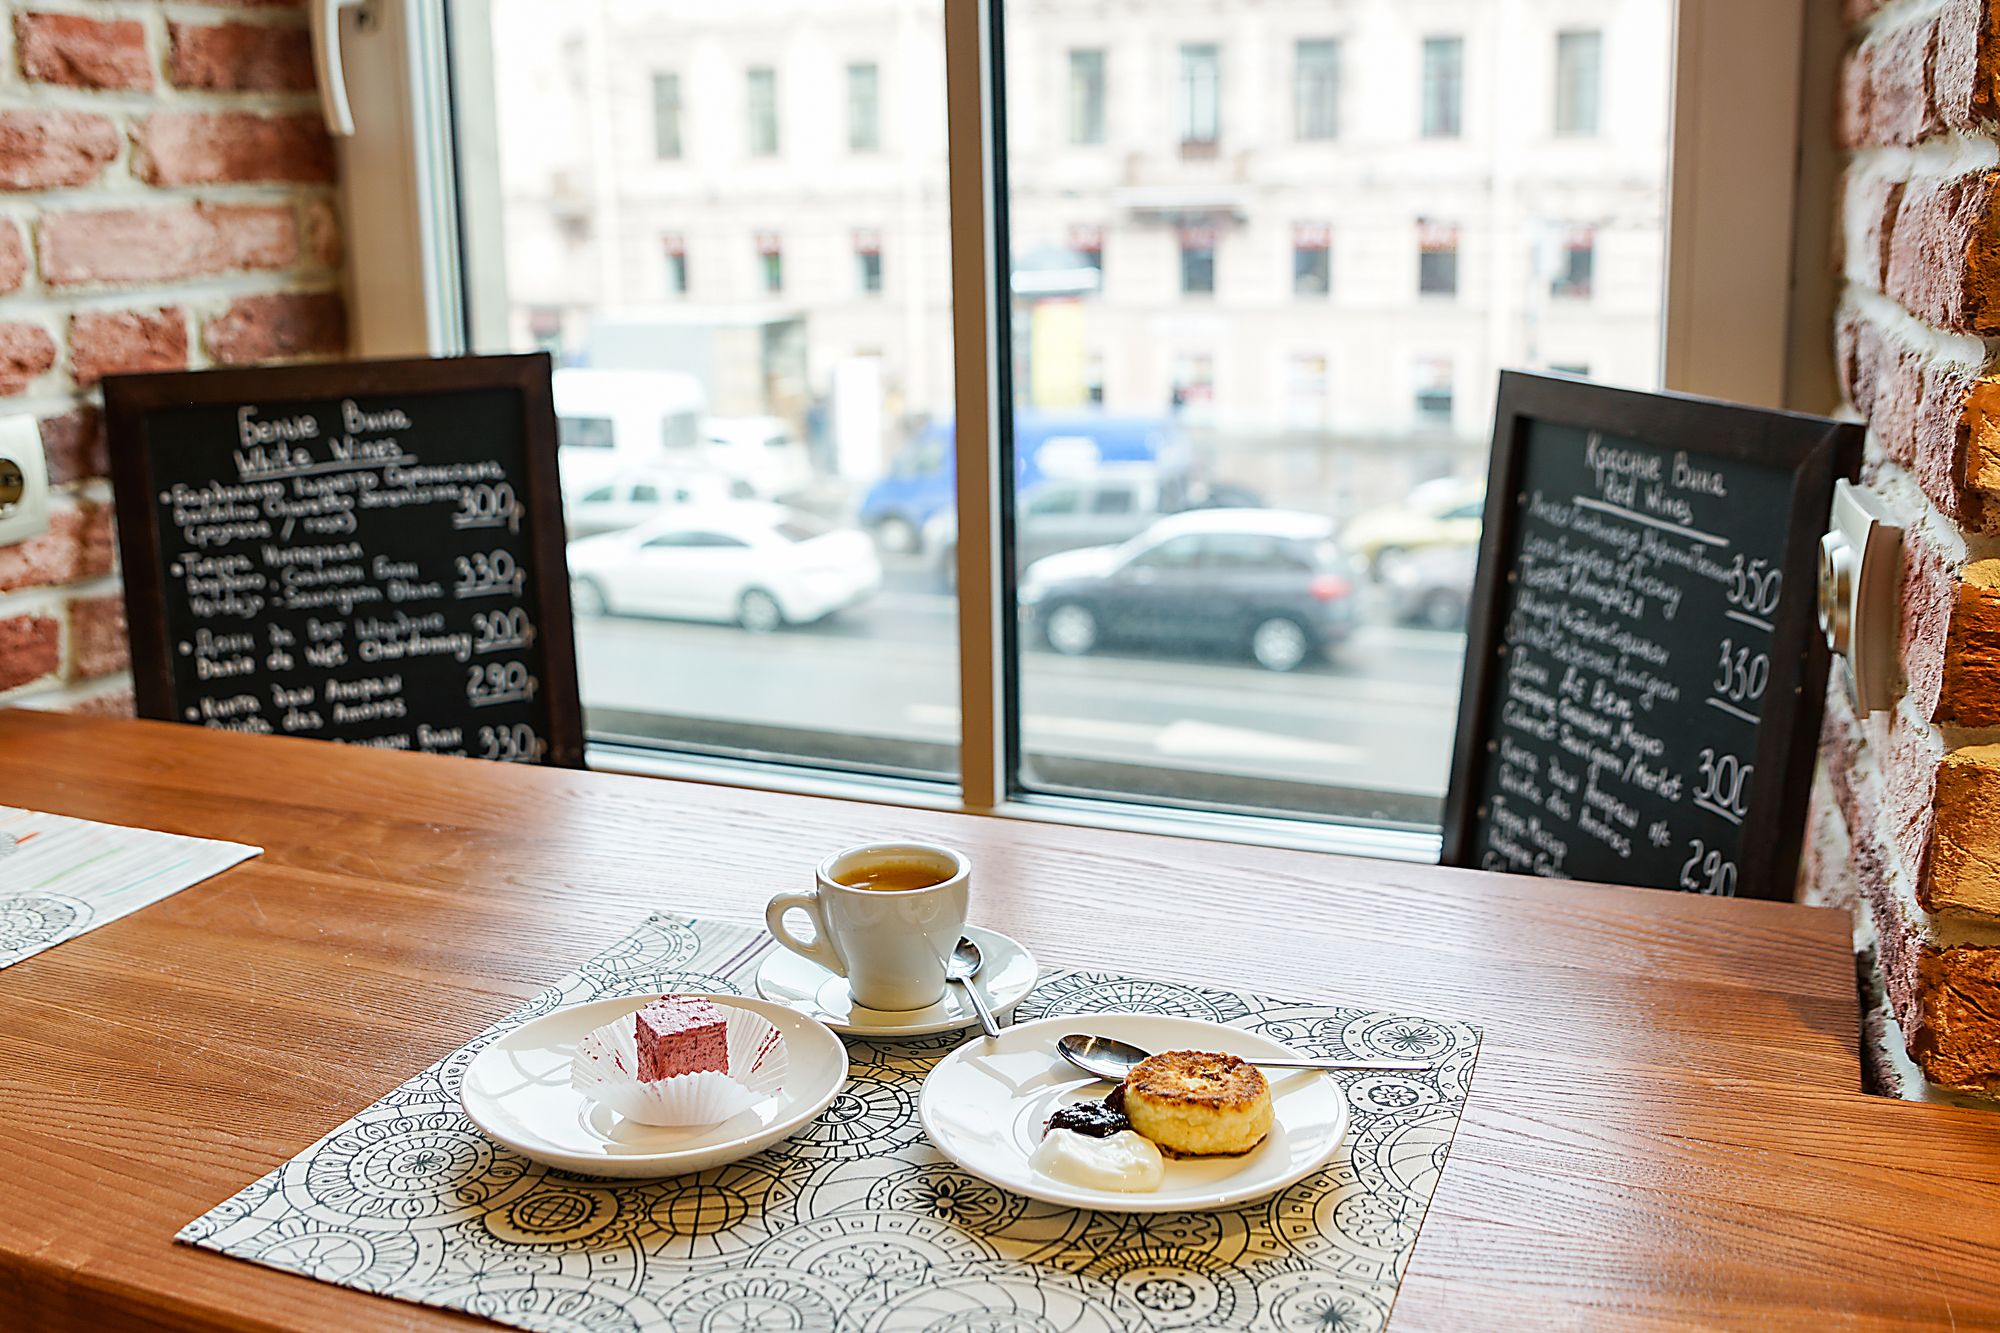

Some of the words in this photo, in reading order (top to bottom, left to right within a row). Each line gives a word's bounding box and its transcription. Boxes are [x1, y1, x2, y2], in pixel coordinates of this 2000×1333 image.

[342, 400, 411, 433] Вина
[234, 438, 313, 476] White
[330, 436, 403, 464] Wines
[1585, 431, 1662, 488] Красные
[1671, 450, 1728, 498] Вина
[1604, 473, 1637, 508] Red
[1645, 481, 1694, 526] Wines
[1726, 554, 1783, 616] 350
[1713, 638, 1770, 702] 330
